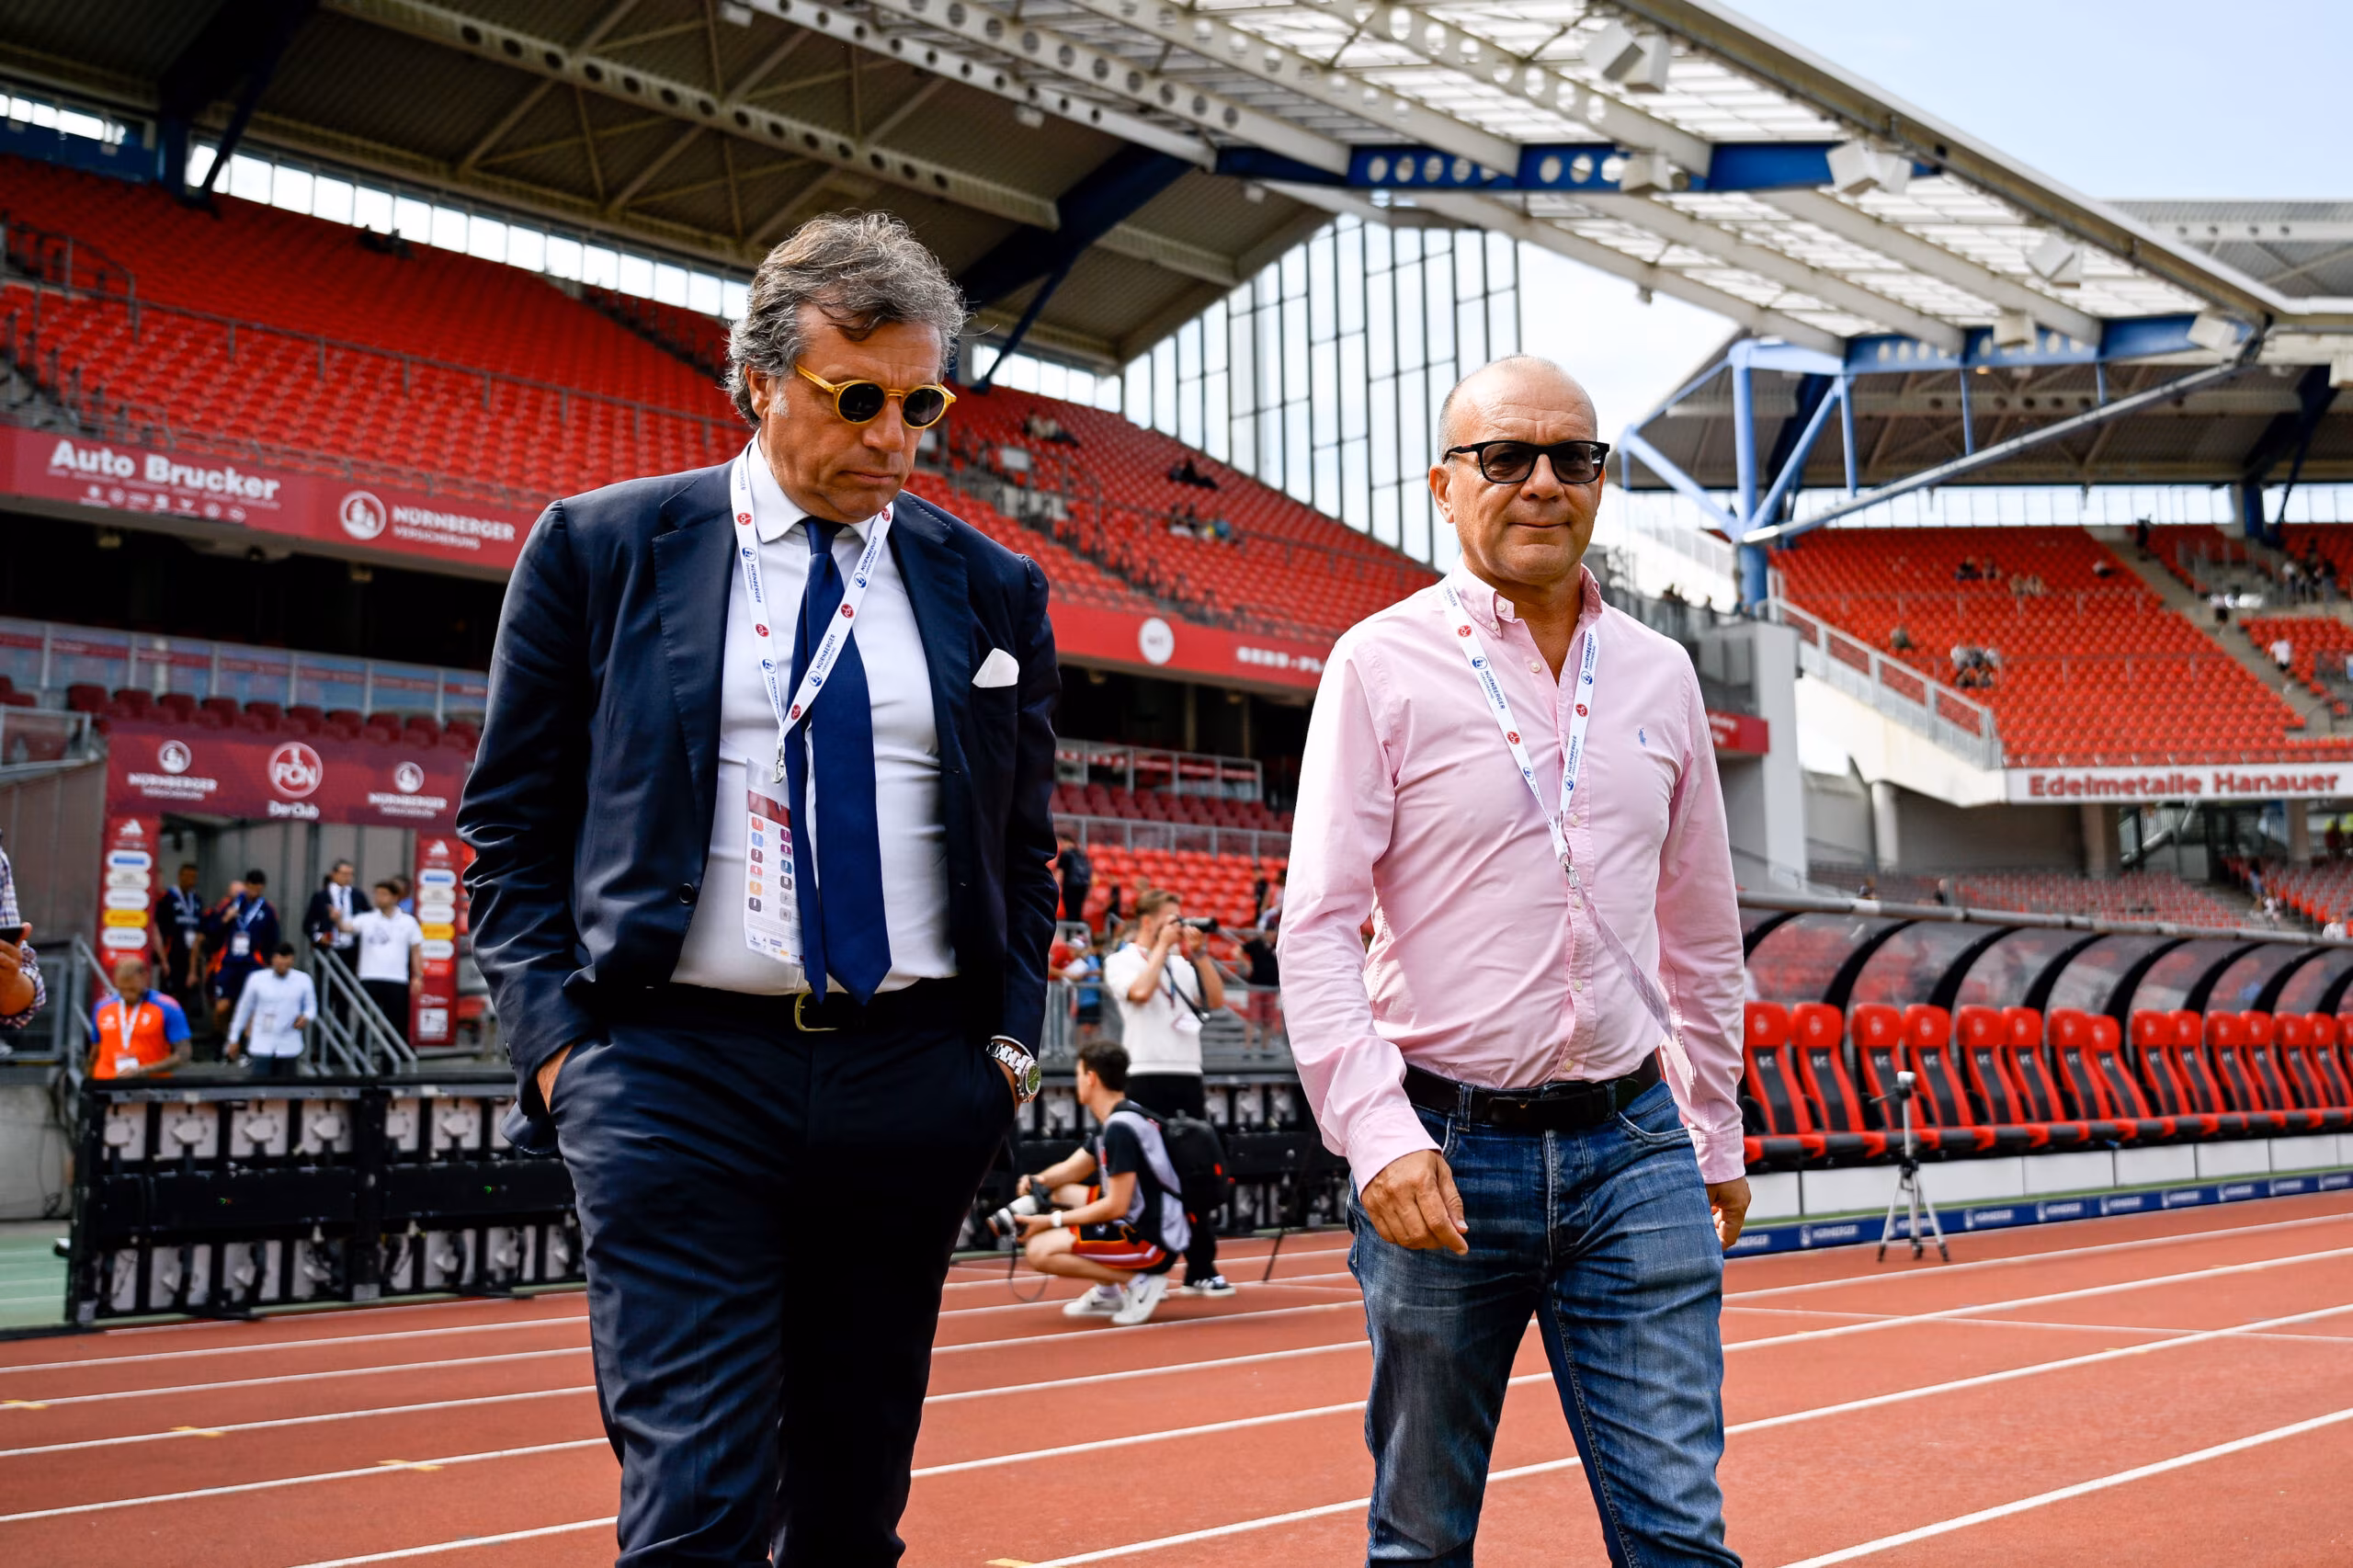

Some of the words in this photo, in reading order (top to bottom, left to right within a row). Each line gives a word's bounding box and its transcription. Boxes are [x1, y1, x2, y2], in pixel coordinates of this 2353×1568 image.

[50, 439, 136, 478] Auto
[144, 453, 281, 500] Brucker
[392, 506, 516, 541] NÜRNBERGER
[860, 536, 878, 572] NÜRNBERGER
[749, 562, 762, 605] NÜRNBERGER
[814, 633, 836, 670] NÜRNBERGER
[1585, 633, 1593, 669] NÜRNBERGER
[1483, 670, 1506, 710] NÜRNBERGER
[1568, 734, 1577, 774] NÜRNBERGER
[2028, 773, 2203, 797] Edelmetalle
[2212, 771, 2339, 793] Hanauer
